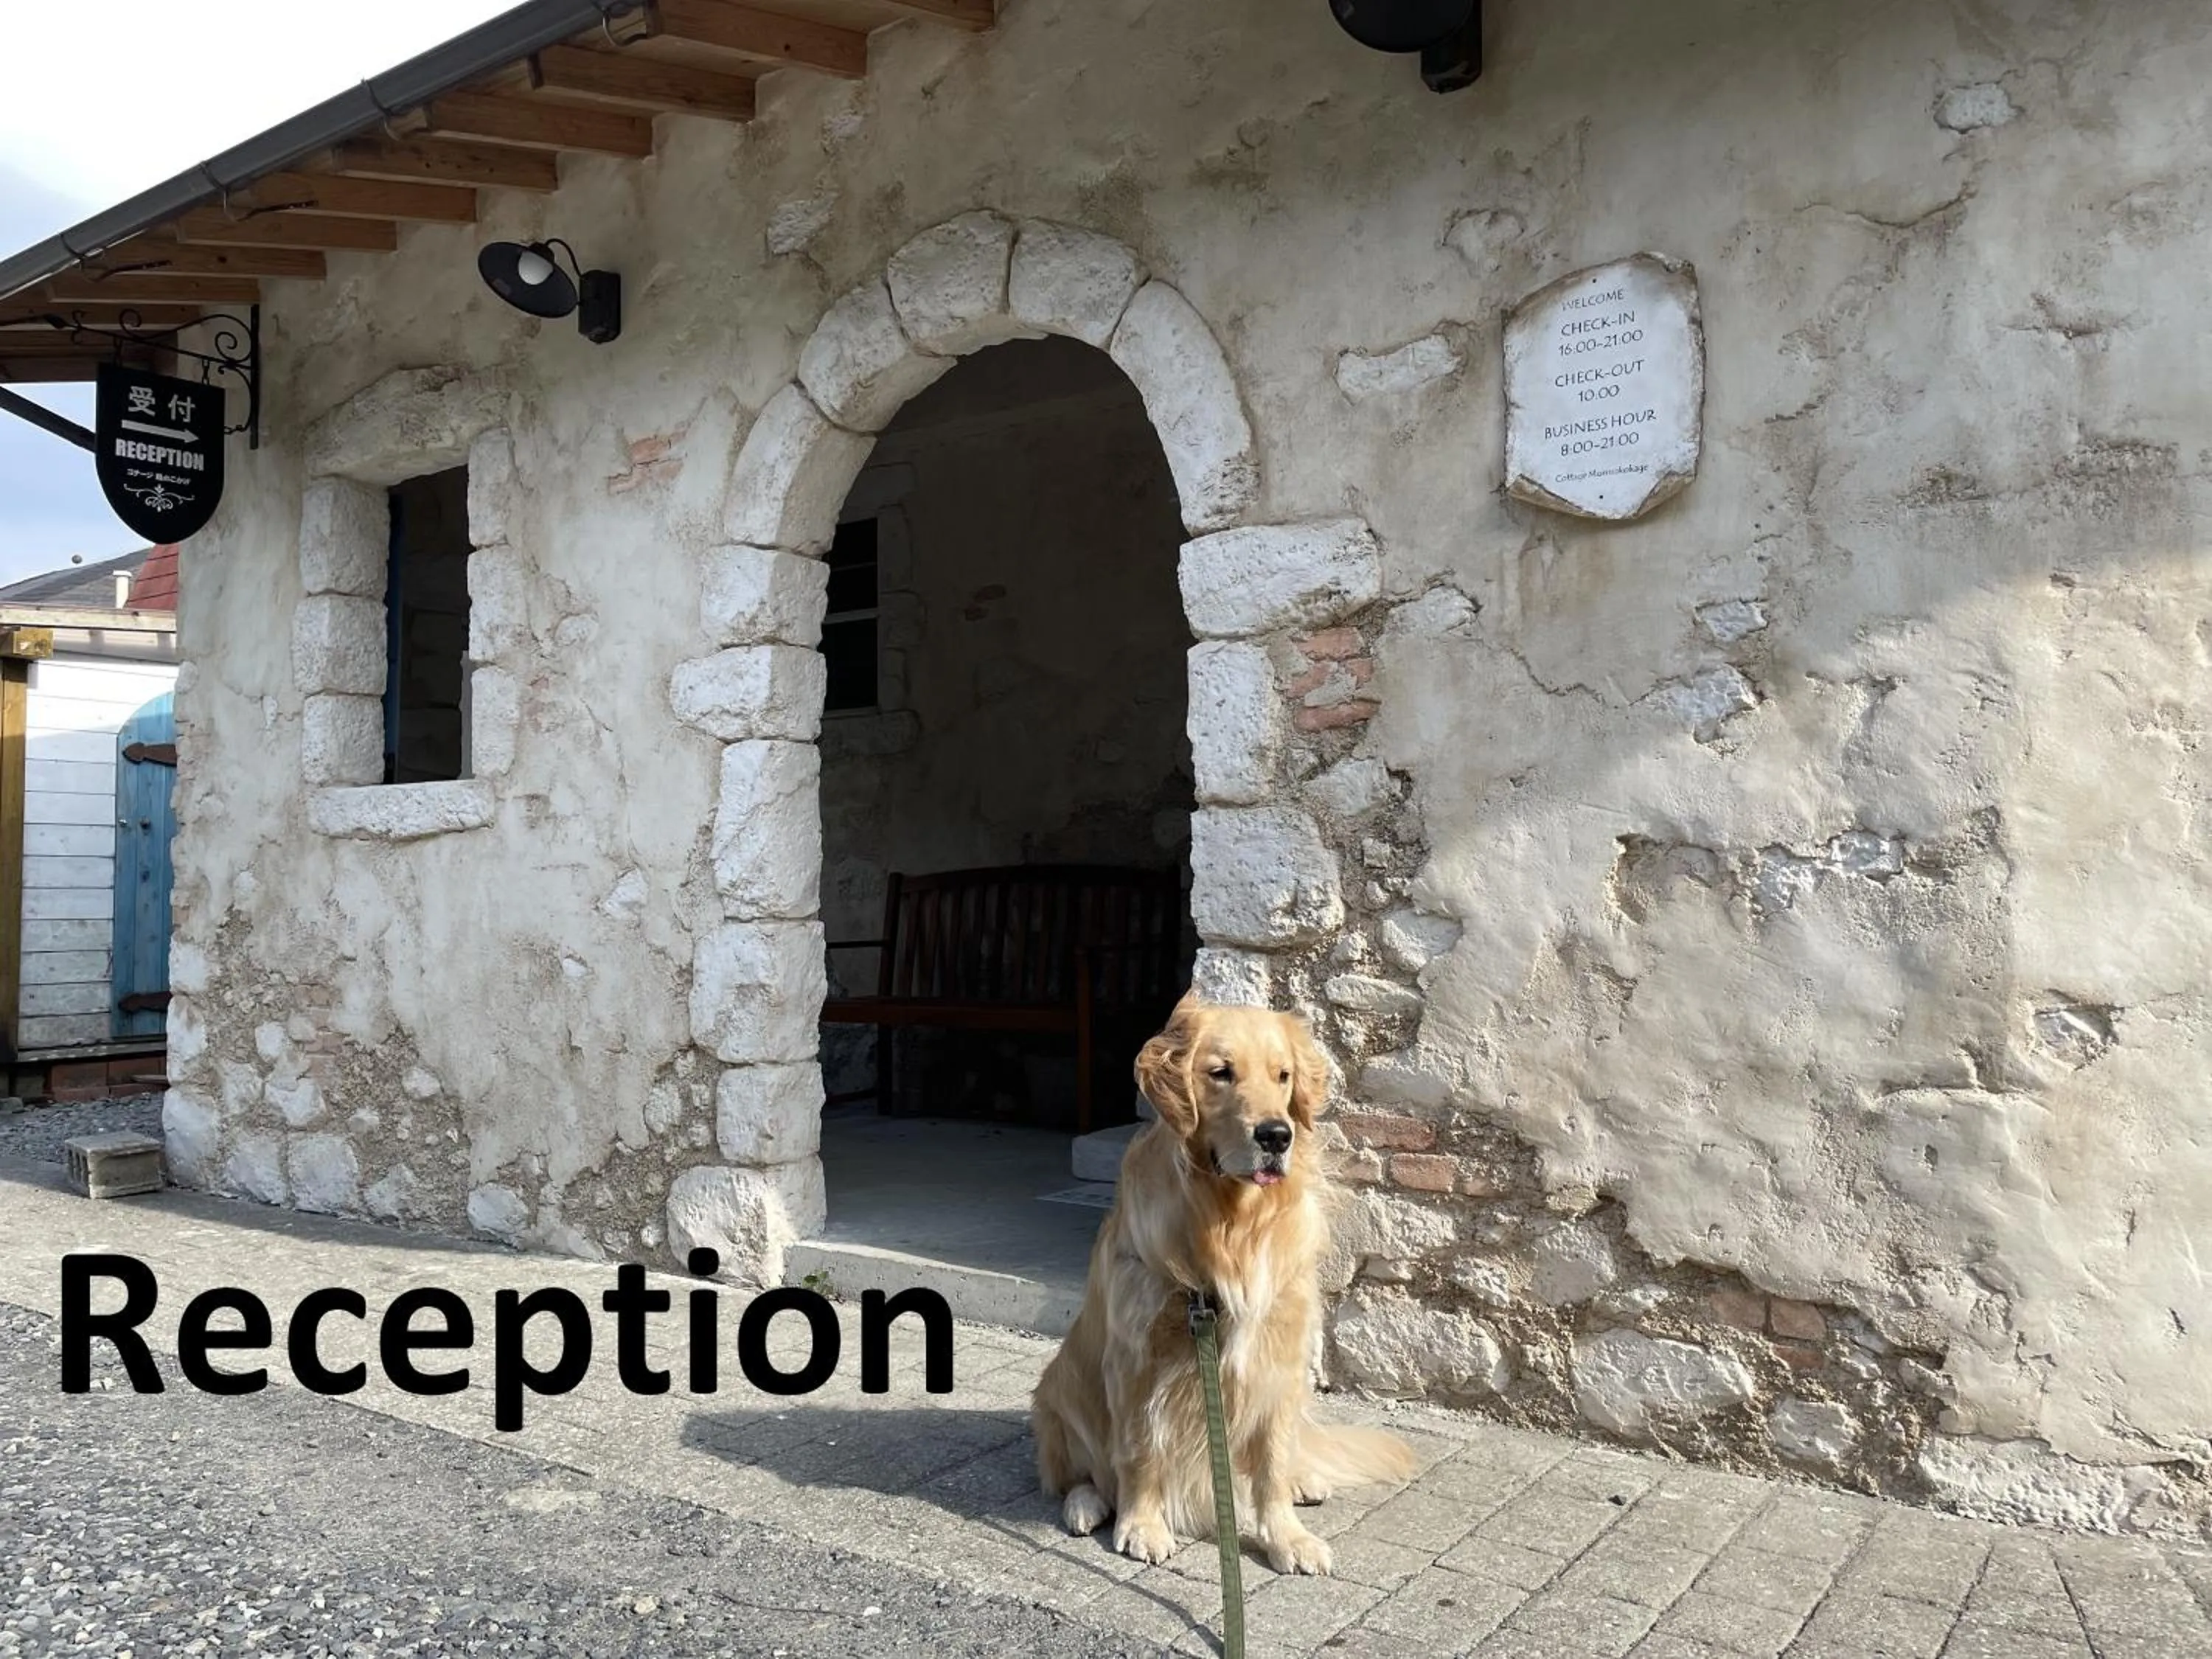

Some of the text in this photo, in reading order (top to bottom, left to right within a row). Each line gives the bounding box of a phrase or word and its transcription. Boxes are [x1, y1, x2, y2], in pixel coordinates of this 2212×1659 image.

[1562, 288, 1624, 311] WELCOME
[1561, 310, 1635, 336] CHECK-IN
[1559, 329, 1644, 356] 16:00-21:00
[1555, 359, 1645, 387] CHECK-OUT
[128, 386, 195, 422] 受付
[1545, 408, 1657, 440] BUSINESS HOUR
[115, 438, 204, 472] RECEPTION
